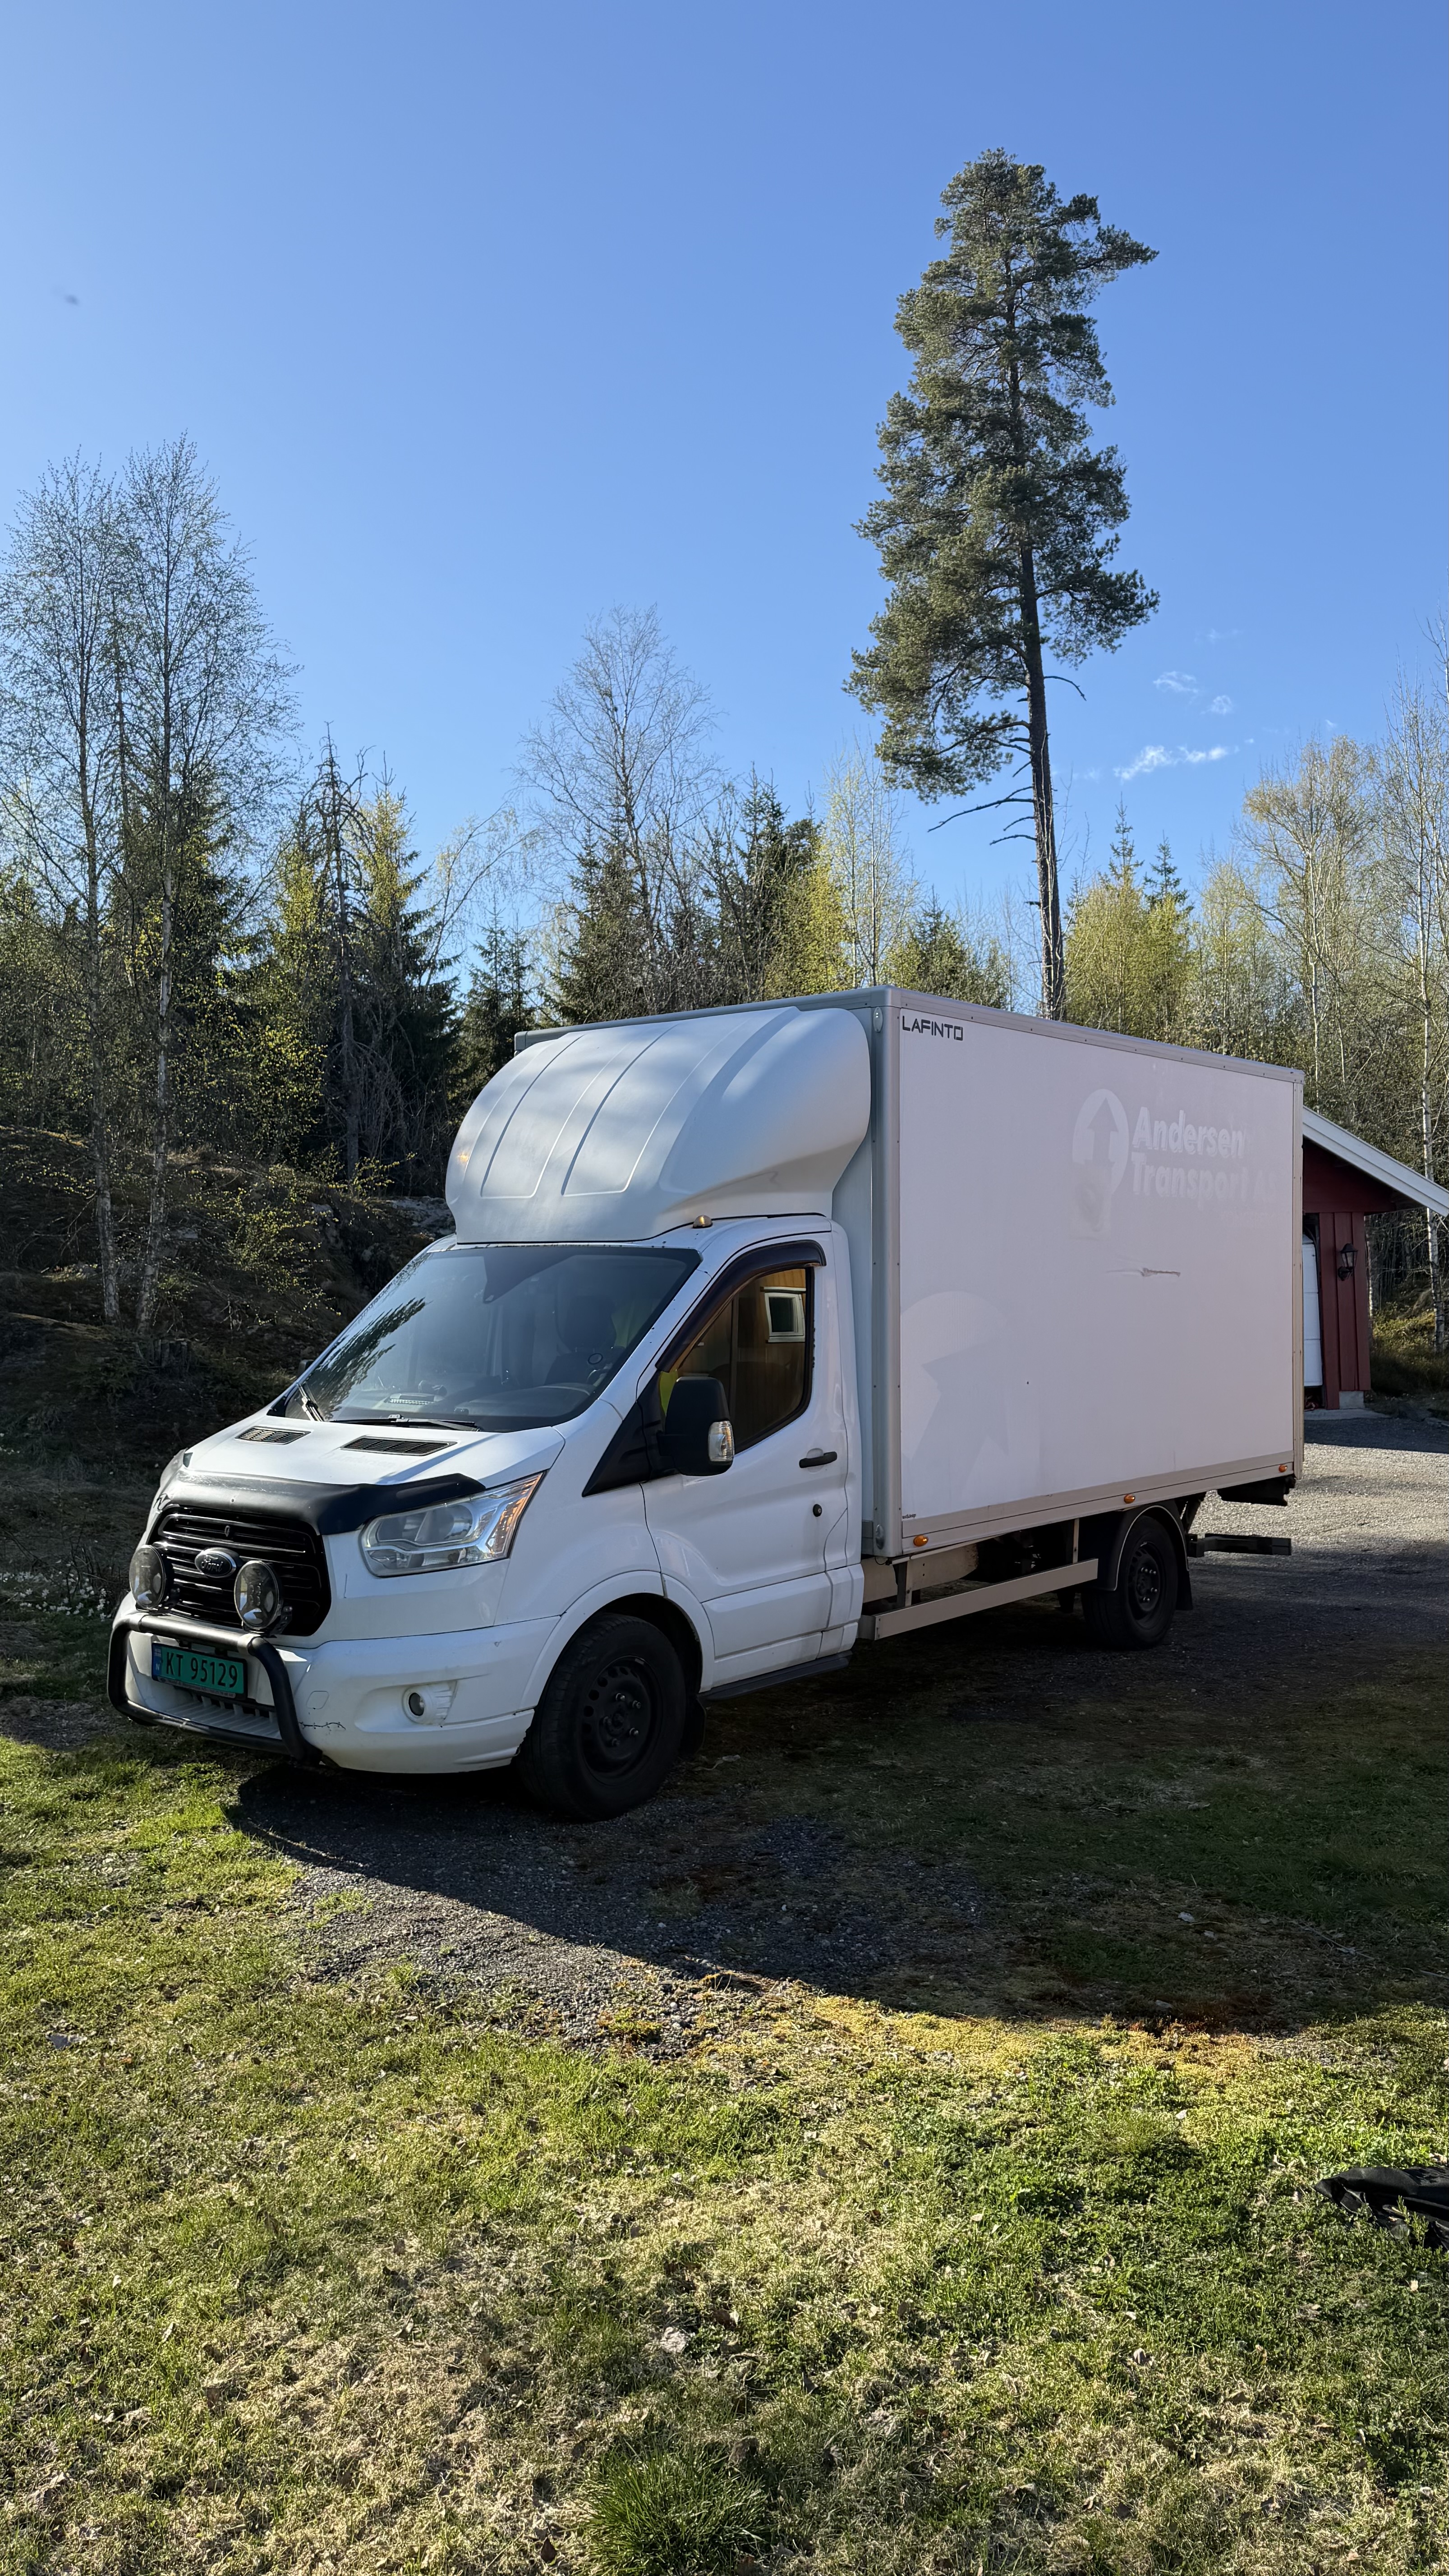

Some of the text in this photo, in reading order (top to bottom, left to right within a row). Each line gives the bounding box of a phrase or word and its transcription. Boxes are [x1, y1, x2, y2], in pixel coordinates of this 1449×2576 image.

[902, 1016, 963, 1041] LAFINTO
[1132, 1107, 1244, 1158] Andersen
[1131, 1152, 1249, 1210] Transport
[201, 1554, 223, 1572] Ford
[166, 1652, 238, 1688] KT 95129
